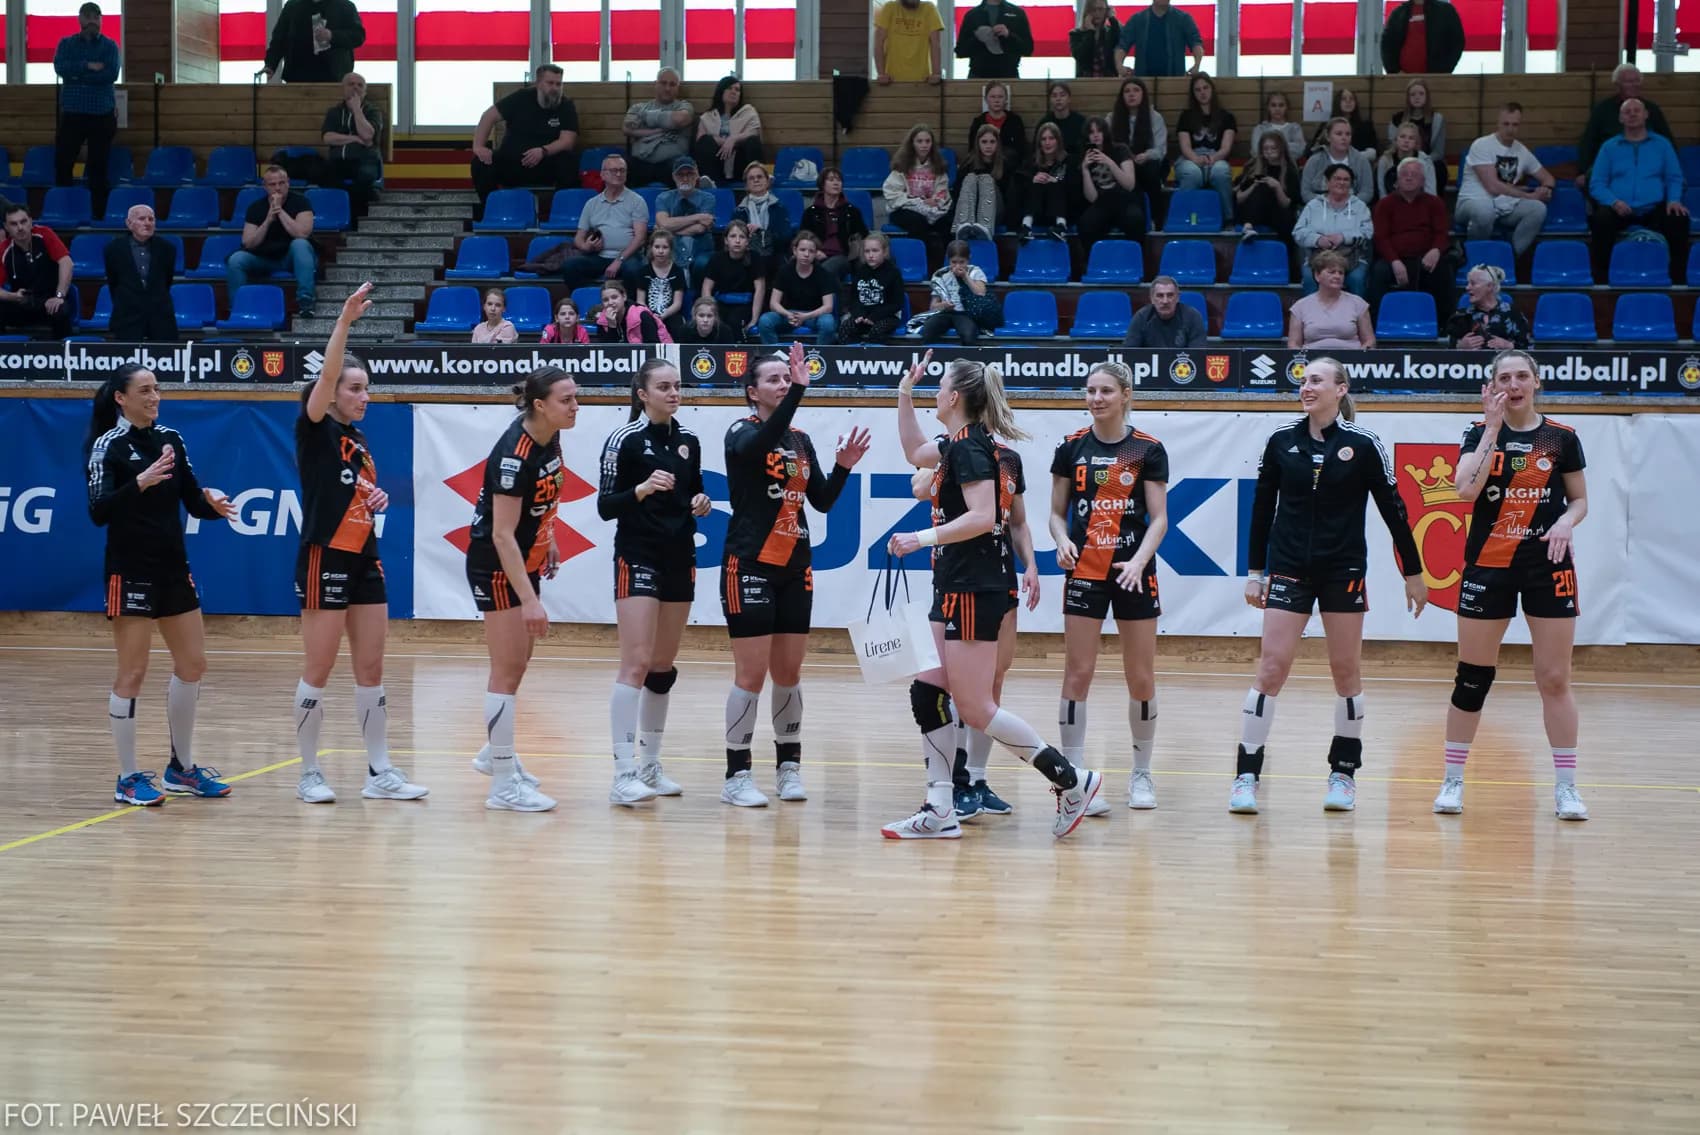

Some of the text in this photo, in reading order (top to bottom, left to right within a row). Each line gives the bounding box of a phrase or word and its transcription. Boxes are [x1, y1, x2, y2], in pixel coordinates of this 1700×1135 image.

[1312, 99, 1324, 113] A
[368, 350, 647, 374] www.koronahandball
[1490, 451, 1505, 476] 0
[534, 475, 556, 503] 26
[1075, 465, 1087, 492] 9
[1505, 487, 1552, 499] KGHM
[1091, 498, 1135, 511] KGHM
[1096, 531, 1135, 546] lubin.pl
[1551, 569, 1574, 597] 20
[864, 638, 902, 658] Lirene
